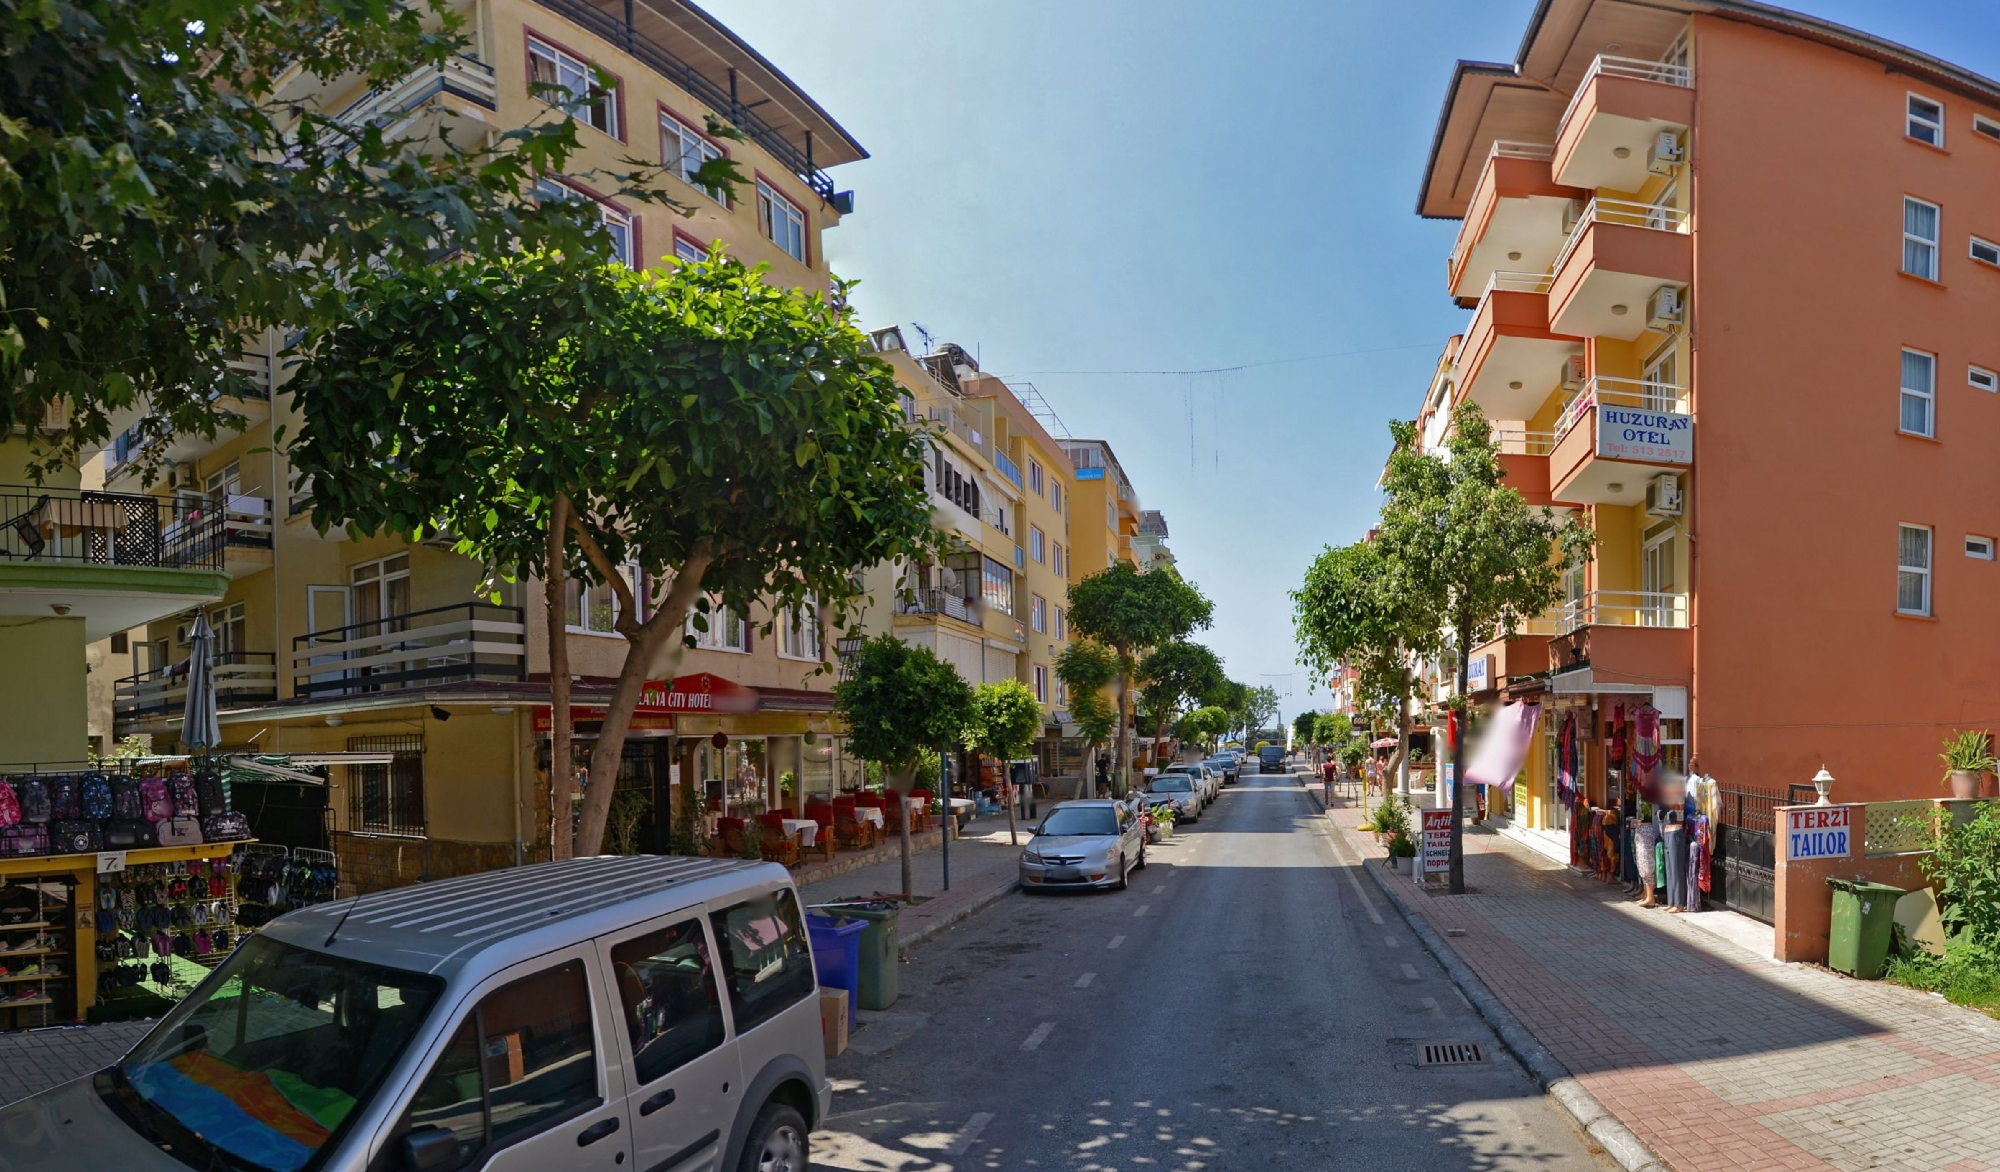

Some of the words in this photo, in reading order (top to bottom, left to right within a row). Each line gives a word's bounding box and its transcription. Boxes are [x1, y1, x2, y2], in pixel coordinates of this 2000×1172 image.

[1606, 411, 1688, 430] HUZURAY
[1623, 429, 1670, 445] OTEL
[1607, 443, 1628, 453] Tel:
[1632, 445, 1654, 456] 513
[1657, 448, 1686, 458] 2517
[667, 692, 686, 708] CITY
[1792, 831, 1846, 857] TAILOR
